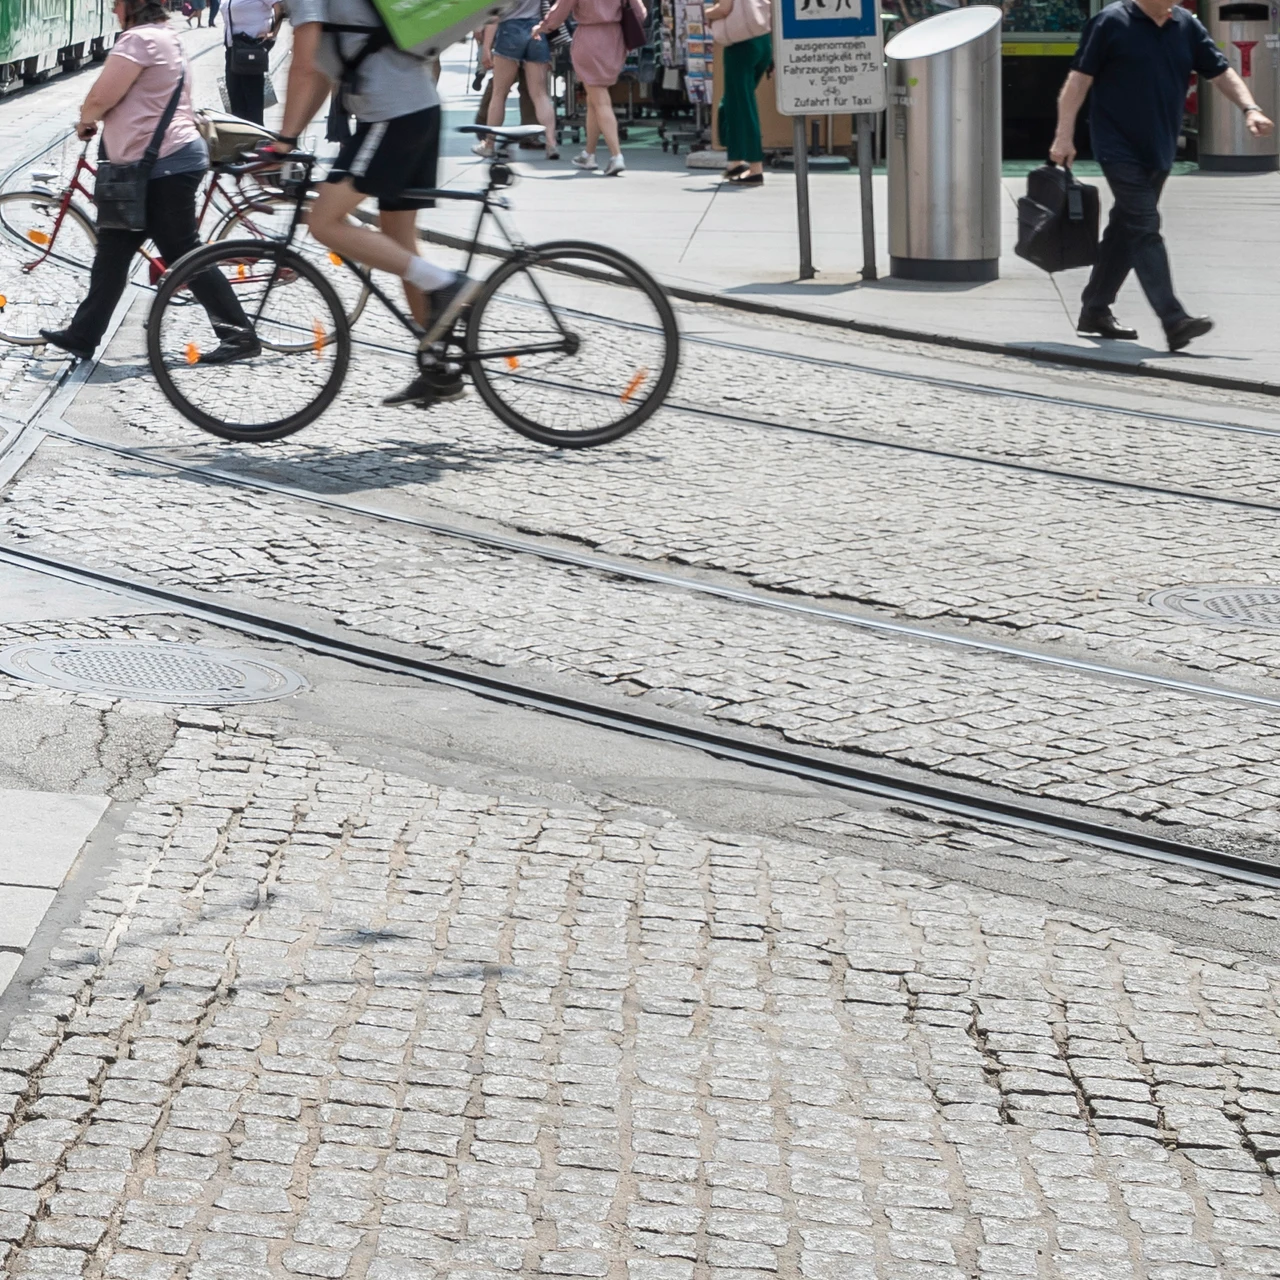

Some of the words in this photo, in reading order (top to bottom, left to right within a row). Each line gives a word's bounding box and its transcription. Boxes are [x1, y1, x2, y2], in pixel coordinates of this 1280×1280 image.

[794, 41, 866, 52] ausgenommen
[789, 52, 852, 64] Ladetätigkeit
[855, 52, 871, 61] mit
[783, 65, 841, 76] Fahrzeugen
[844, 63, 858, 73] bis
[794, 97, 830, 108] Zufahrt
[834, 96, 849, 106] für
[852, 95, 872, 106] Taxi
